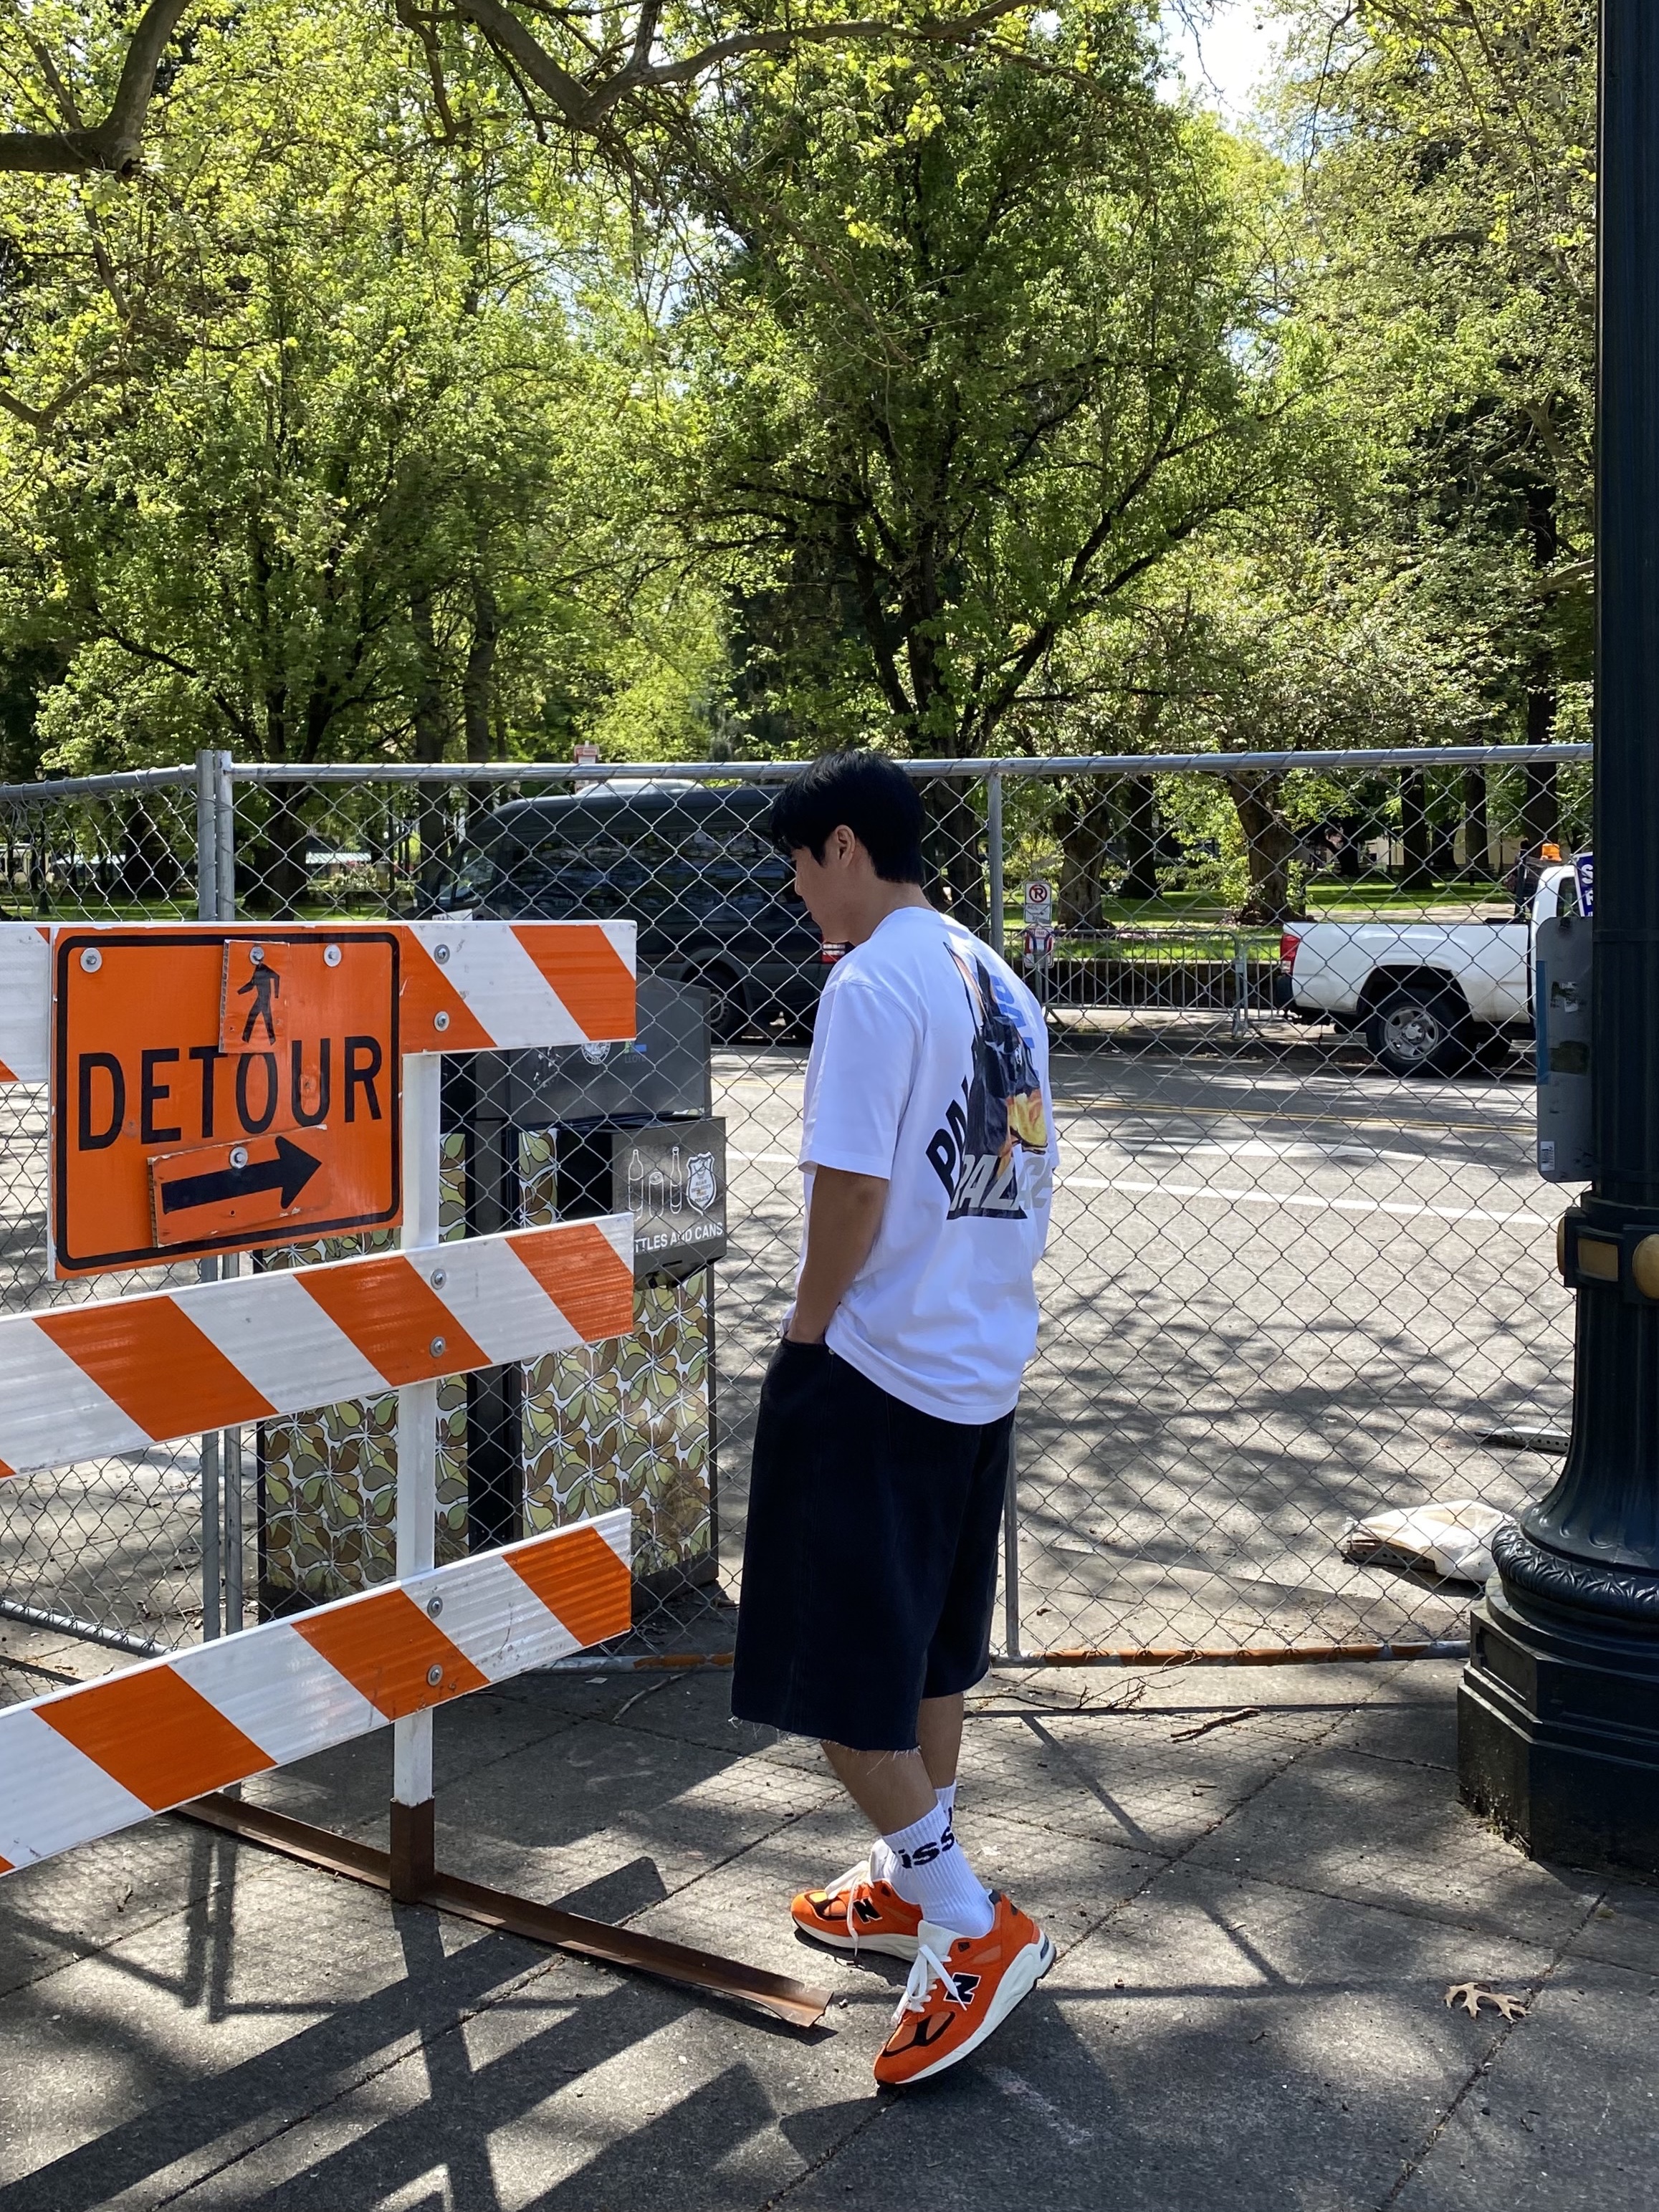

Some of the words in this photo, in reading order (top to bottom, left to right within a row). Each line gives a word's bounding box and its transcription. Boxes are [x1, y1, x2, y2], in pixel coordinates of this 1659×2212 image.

[78, 1035, 383, 1152] DETOUR
[634, 1233, 668, 1253] TTLES
[695, 1222, 723, 1240] CANS
[893, 1826, 955, 1869] iss
